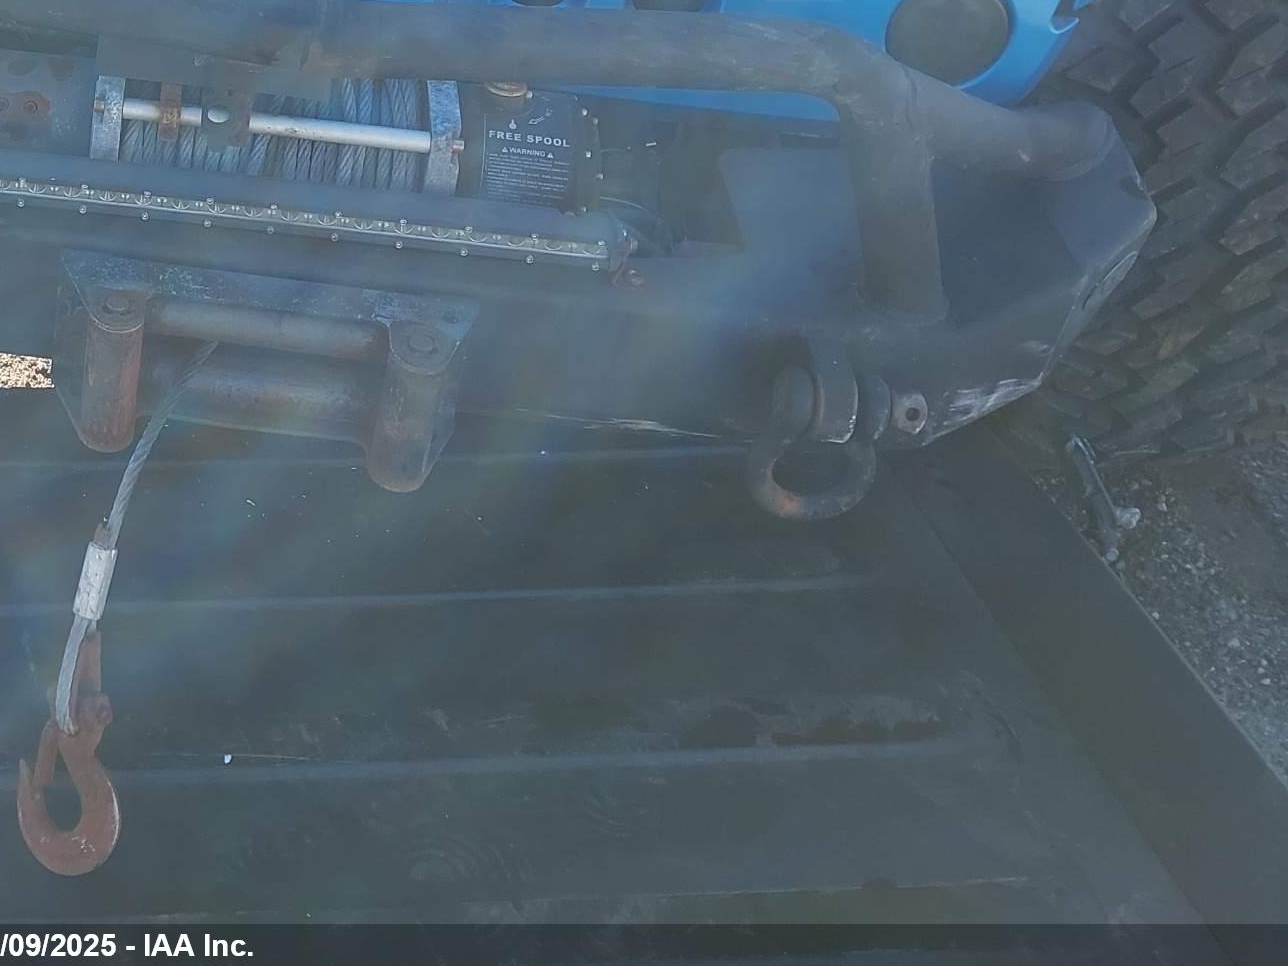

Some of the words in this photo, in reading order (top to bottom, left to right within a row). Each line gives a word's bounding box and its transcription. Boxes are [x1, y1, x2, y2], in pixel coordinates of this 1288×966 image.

[488, 130, 522, 142] FREE
[526, 134, 571, 148] SPOOL
[509, 146, 546, 158] WARNING
